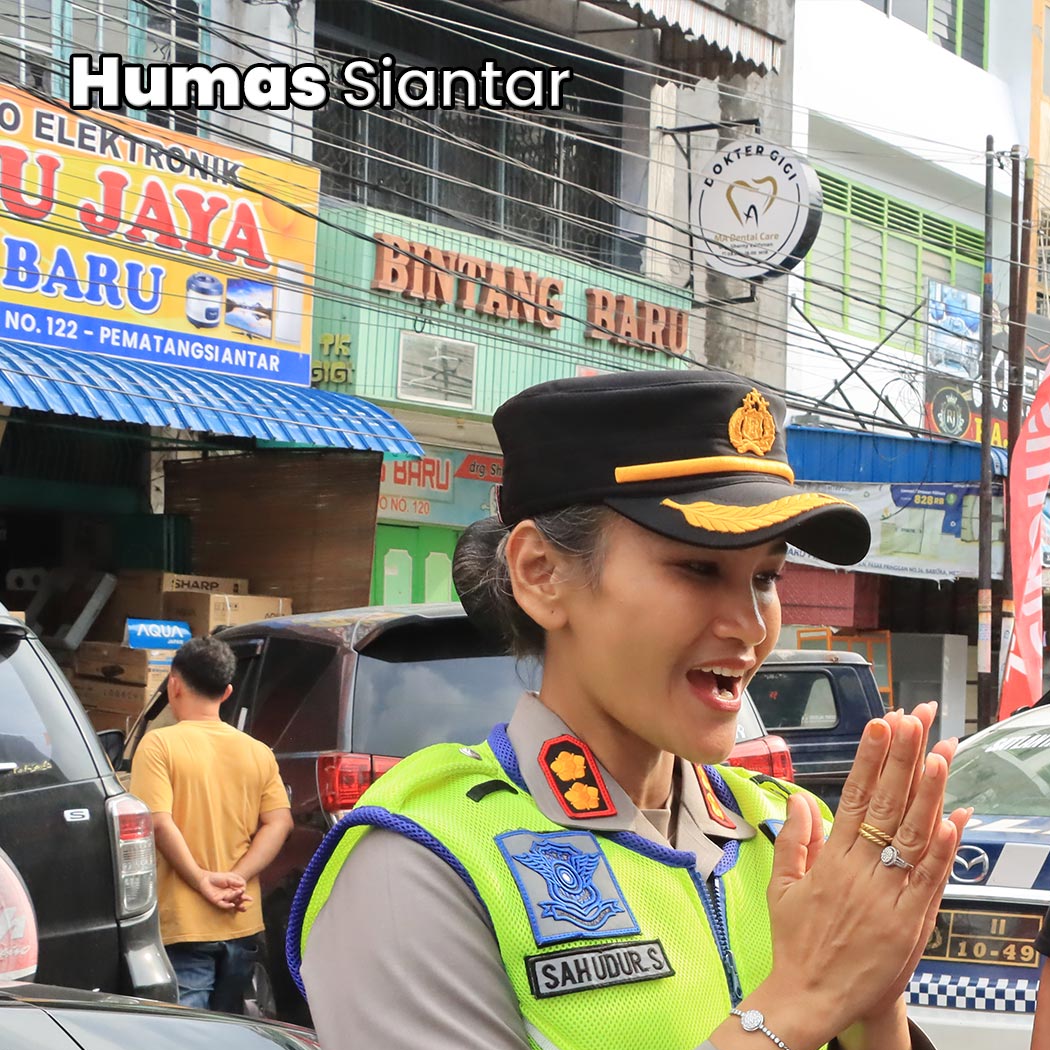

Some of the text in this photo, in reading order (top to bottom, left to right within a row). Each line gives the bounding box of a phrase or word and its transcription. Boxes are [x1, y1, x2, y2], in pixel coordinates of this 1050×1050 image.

[34, 111, 242, 187] ELEKTRONIK
[704, 145, 797, 188] DOKTER GIGI
[79, 170, 270, 270] JAYA
[730, 233, 758, 242] Dental
[760, 233, 779, 241] Care
[2, 237, 165, 313] BARU
[371, 232, 689, 357] BINTANG BARU
[5, 310, 41, 334] NO.
[47, 317, 78, 340] 122
[100, 327, 280, 372] PEMATANGSIANTAR
[393, 458, 450, 491] BARU
[469, 461, 486, 478] drg
[390, 497, 409, 512] NO.
[413, 501, 430, 515] 120
[914, 494, 934, 505] 828
[173, 579, 219, 591] SHARP
[136, 623, 185, 638] AQUA
[957, 942, 1034, 961] 10-49
